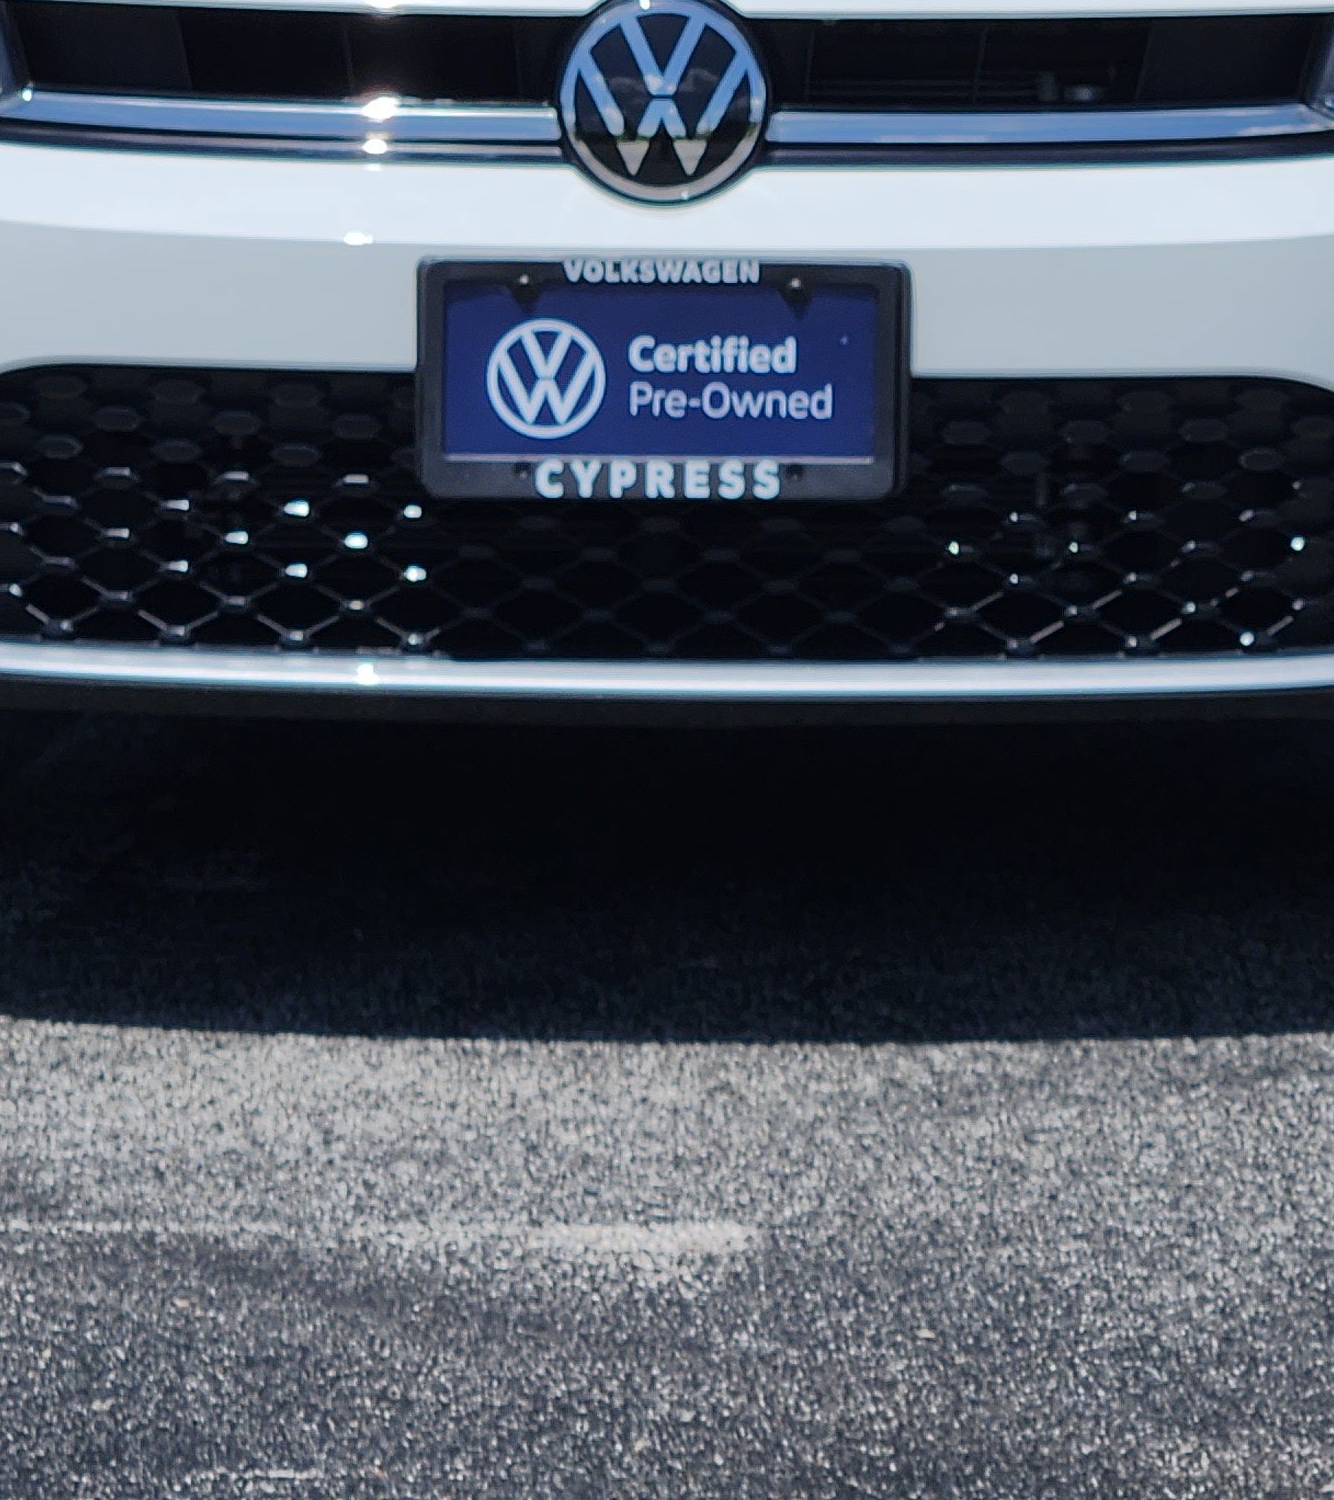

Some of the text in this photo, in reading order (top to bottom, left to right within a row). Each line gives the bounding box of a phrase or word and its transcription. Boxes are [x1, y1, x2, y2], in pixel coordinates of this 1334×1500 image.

[563, 258, 760, 283] VOLKSWAGEN
[628, 335, 797, 374] Certified
[628, 381, 833, 420] Pre-Owned
[534, 457, 782, 500] CYPRESS
